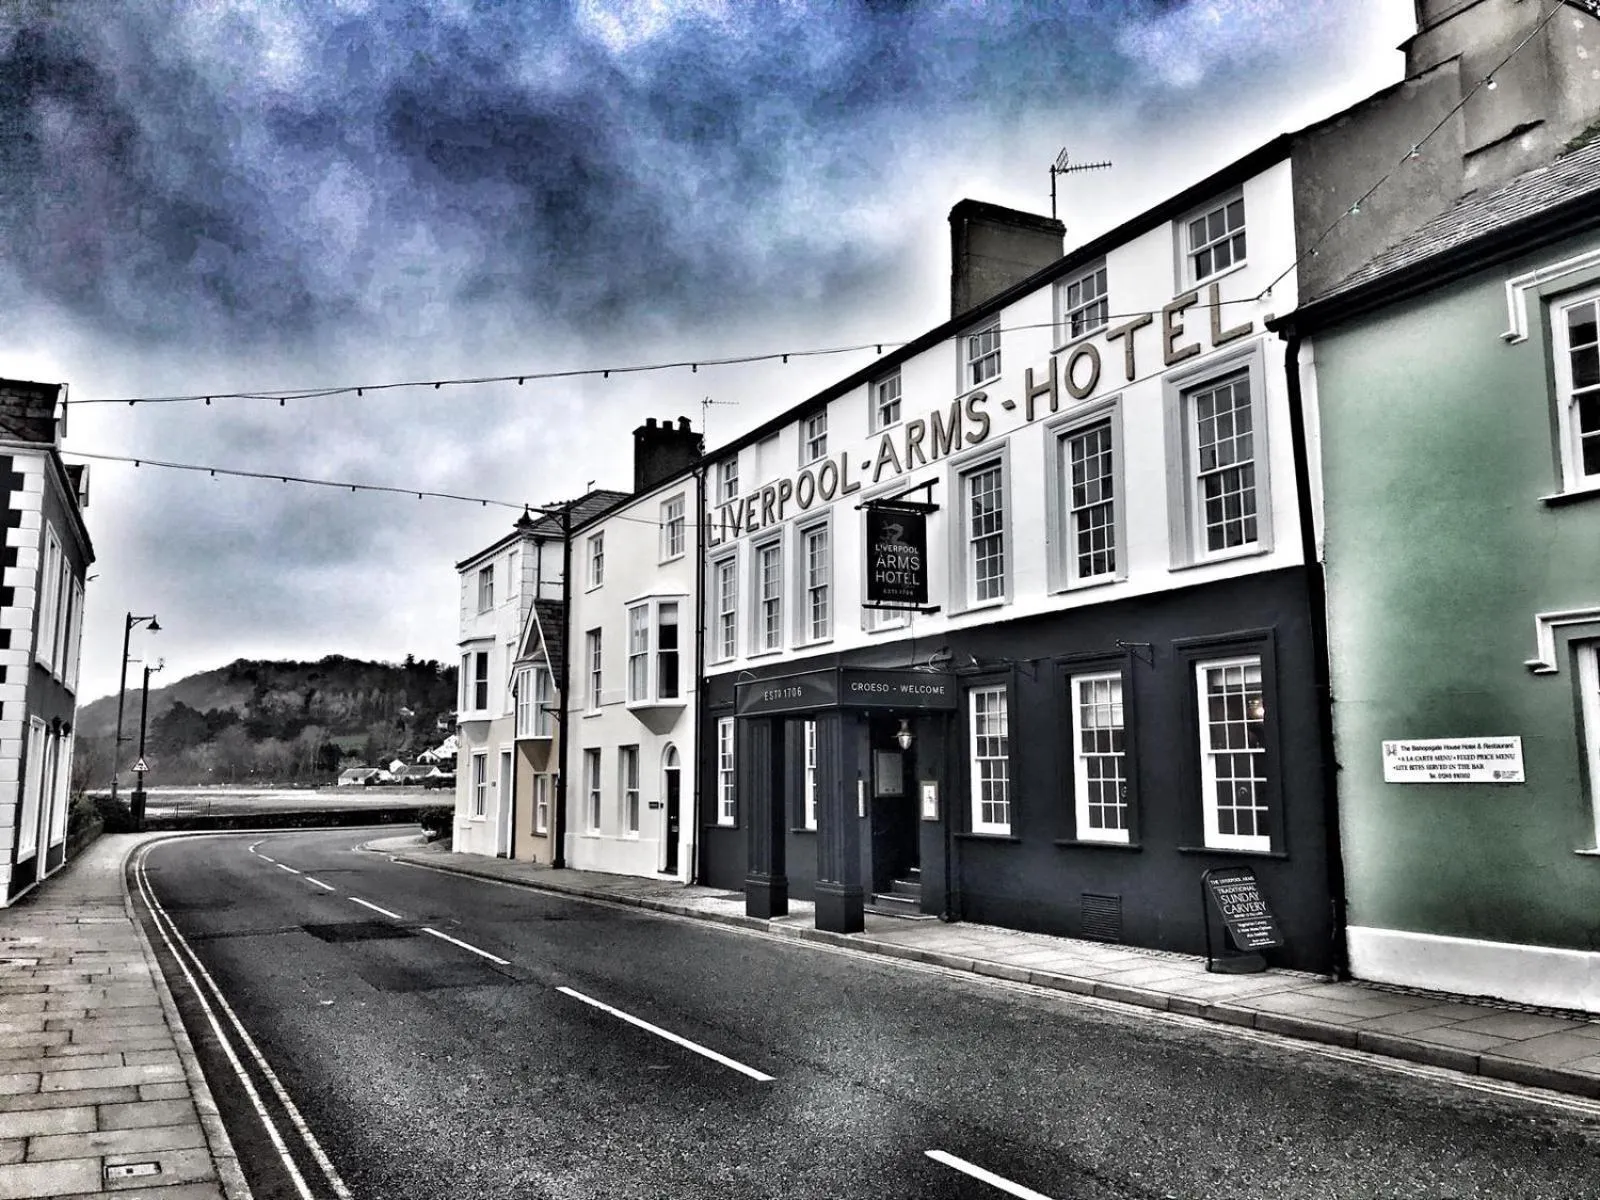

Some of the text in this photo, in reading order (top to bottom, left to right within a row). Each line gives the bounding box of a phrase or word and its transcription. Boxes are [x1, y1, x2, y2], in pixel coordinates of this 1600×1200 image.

[706, 452, 861, 548] LIVERPOOL
[872, 391, 991, 483] ARMS
[1024, 282, 1254, 422] HOTEL
[875, 543, 919, 555] LIVERPOOL
[876, 554, 920, 571] ARMS
[875, 570, 920, 586] HOTEL
[783, 686, 802, 698] 1706
[851, 682, 890, 692] CROESO
[900, 685, 945, 695] WELCOME
[1483, 742, 1514, 750] Restaurant
[1217, 886, 1257, 895] TRADITIONAL
[1220, 891, 1260, 905] SUNDAY
[1223, 901, 1267, 915] CARVERY
